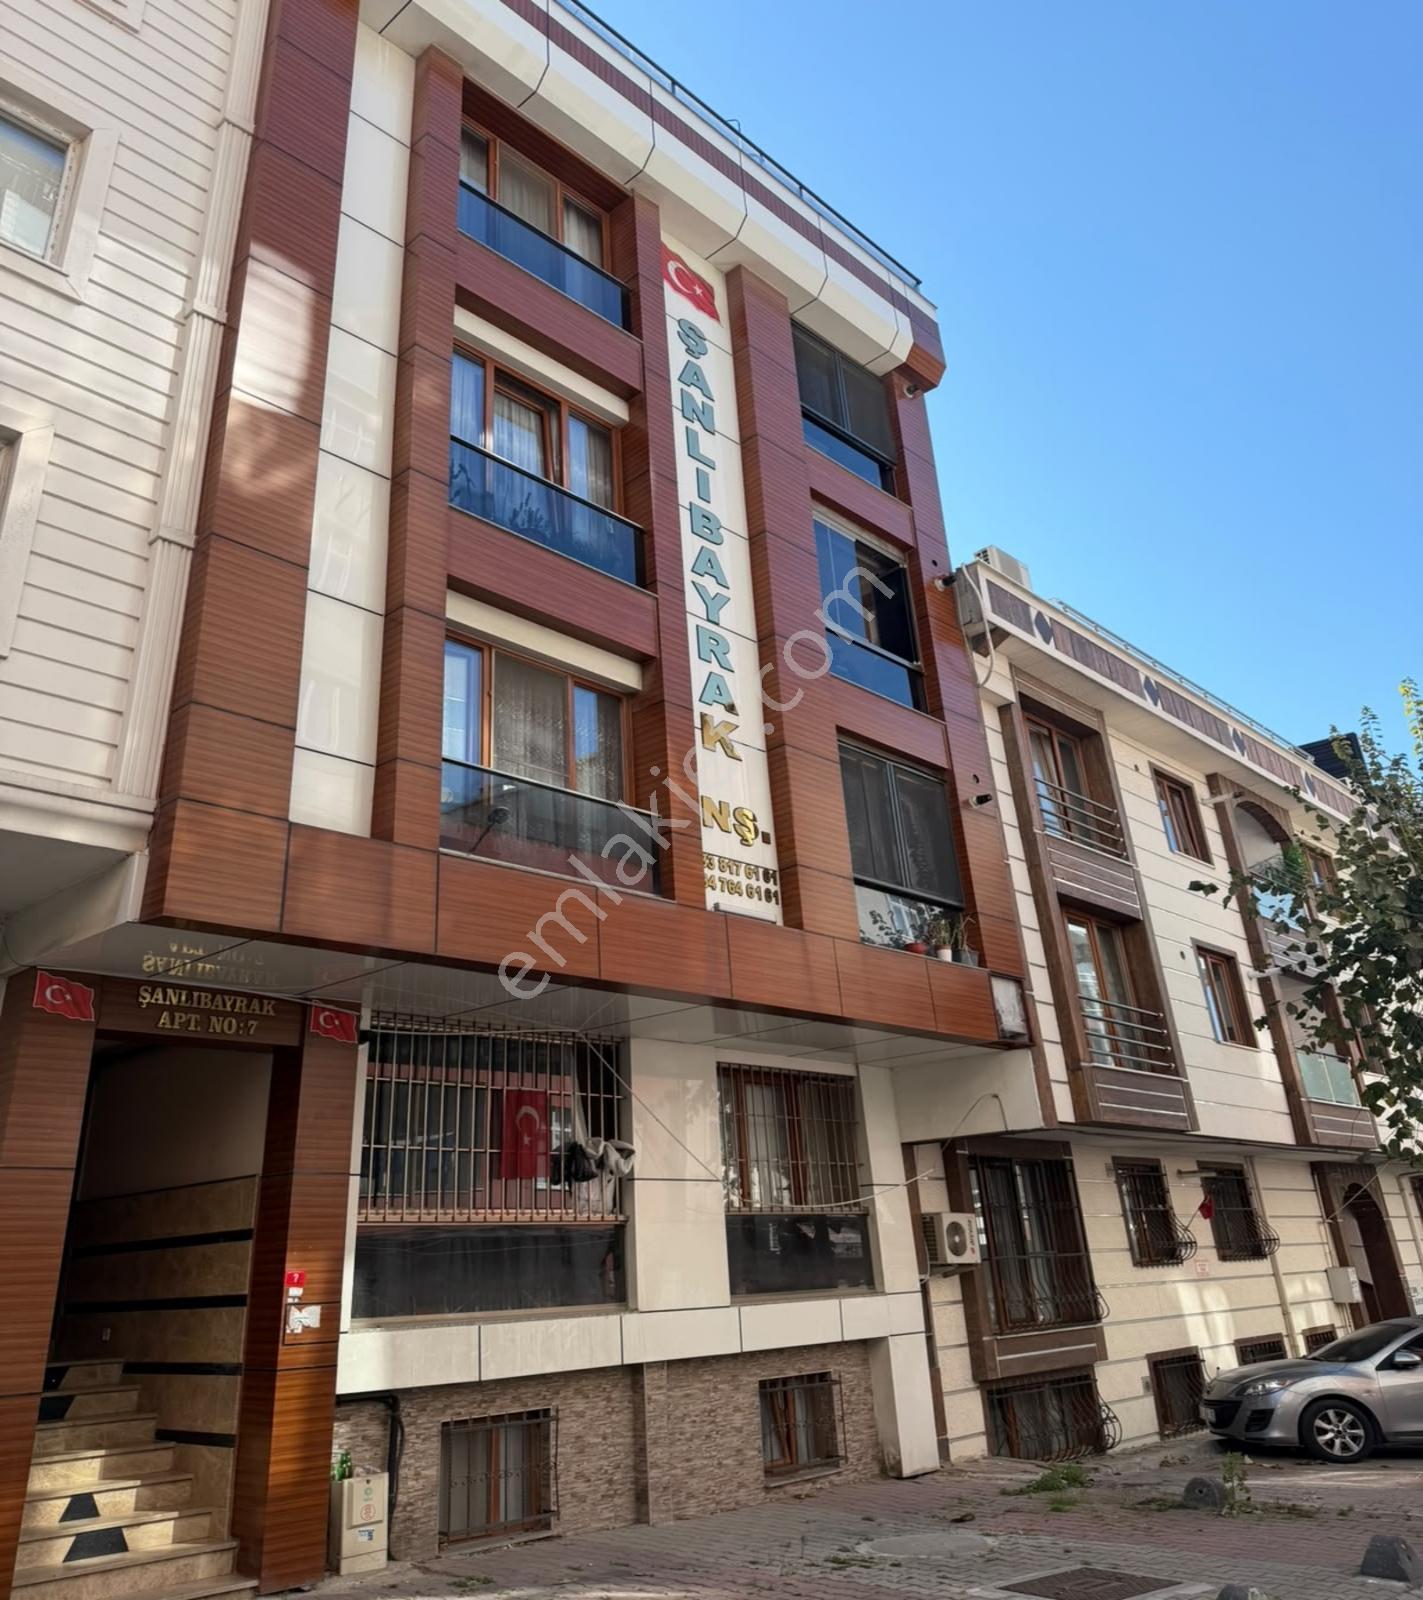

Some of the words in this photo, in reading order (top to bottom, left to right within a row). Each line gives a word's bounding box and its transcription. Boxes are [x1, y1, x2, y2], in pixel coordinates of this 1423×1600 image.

[677, 317, 743, 762] ŞANLIBAYRAK
[744, 864, 760, 881] 61
[718, 876, 743, 897] 764
[745, 883, 762, 901] 61
[138, 985, 277, 1017] ŞANLIBAYRAK
[157, 1010, 200, 1031] APT.
